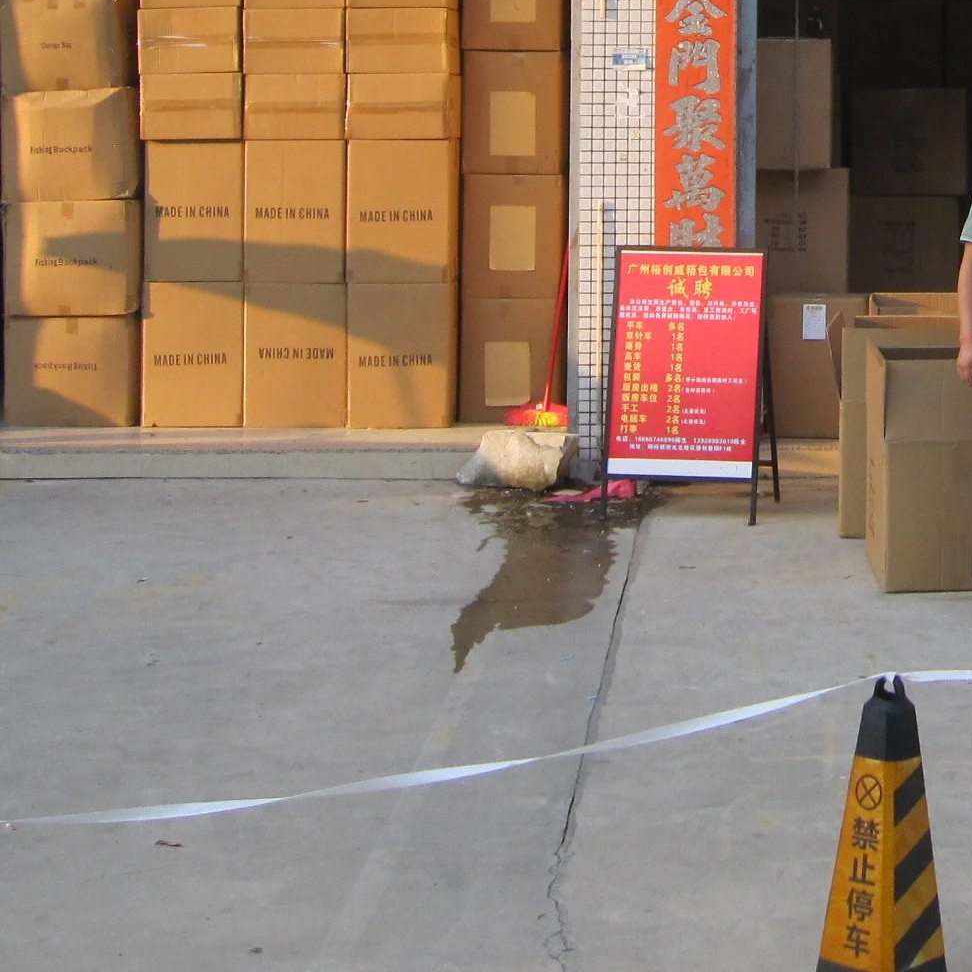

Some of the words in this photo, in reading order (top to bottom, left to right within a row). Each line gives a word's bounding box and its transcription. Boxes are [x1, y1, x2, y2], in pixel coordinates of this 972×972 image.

[30, 146, 53, 154] Fishing
[53, 145, 93, 153] Backpack
[156, 206, 182, 218] MADE
[186, 206, 196, 218] IN
[200, 206, 230, 218] CHINA
[255, 208, 282, 219] MADE
[286, 208, 296, 219] IN
[299, 208, 330, 219] CHINA
[360, 211, 386, 222] MADE
[390, 211, 400, 221] IN
[403, 210, 433, 222] CHINA
[35, 258, 57, 267] Fishing
[59, 258, 98, 266] Backpack
[666, 277, 713, 300] 诚聘
[626, 321, 644, 330] 平车
[668, 322, 685, 331] 多名
[671, 333, 684, 341] 1名
[671, 343, 683, 352] 1名
[259, 348, 290, 359] CHINA
[293, 348, 303, 359] IN
[306, 348, 334, 359] MADE
[625, 352, 642, 361] 高车
[671, 353, 683, 362] 1名
[154, 354, 180, 366] MADE
[184, 354, 194, 365] IN
[197, 353, 227, 365] CHINA
[359, 356, 385, 367] MADE
[389, 355, 399, 366] IN
[402, 354, 433, 366] CHINA
[670, 363, 682, 372] 1名
[665, 374, 681, 383] 多名
[668, 384, 681, 393] 2名
[667, 395, 680, 403] 2名
[621, 404, 638, 412] 手工
[667, 405, 680, 414] 2名
[666, 416, 679, 424] 2名
[667, 426, 679, 435] 1名
[843, 816, 880, 957] 禁止停车
